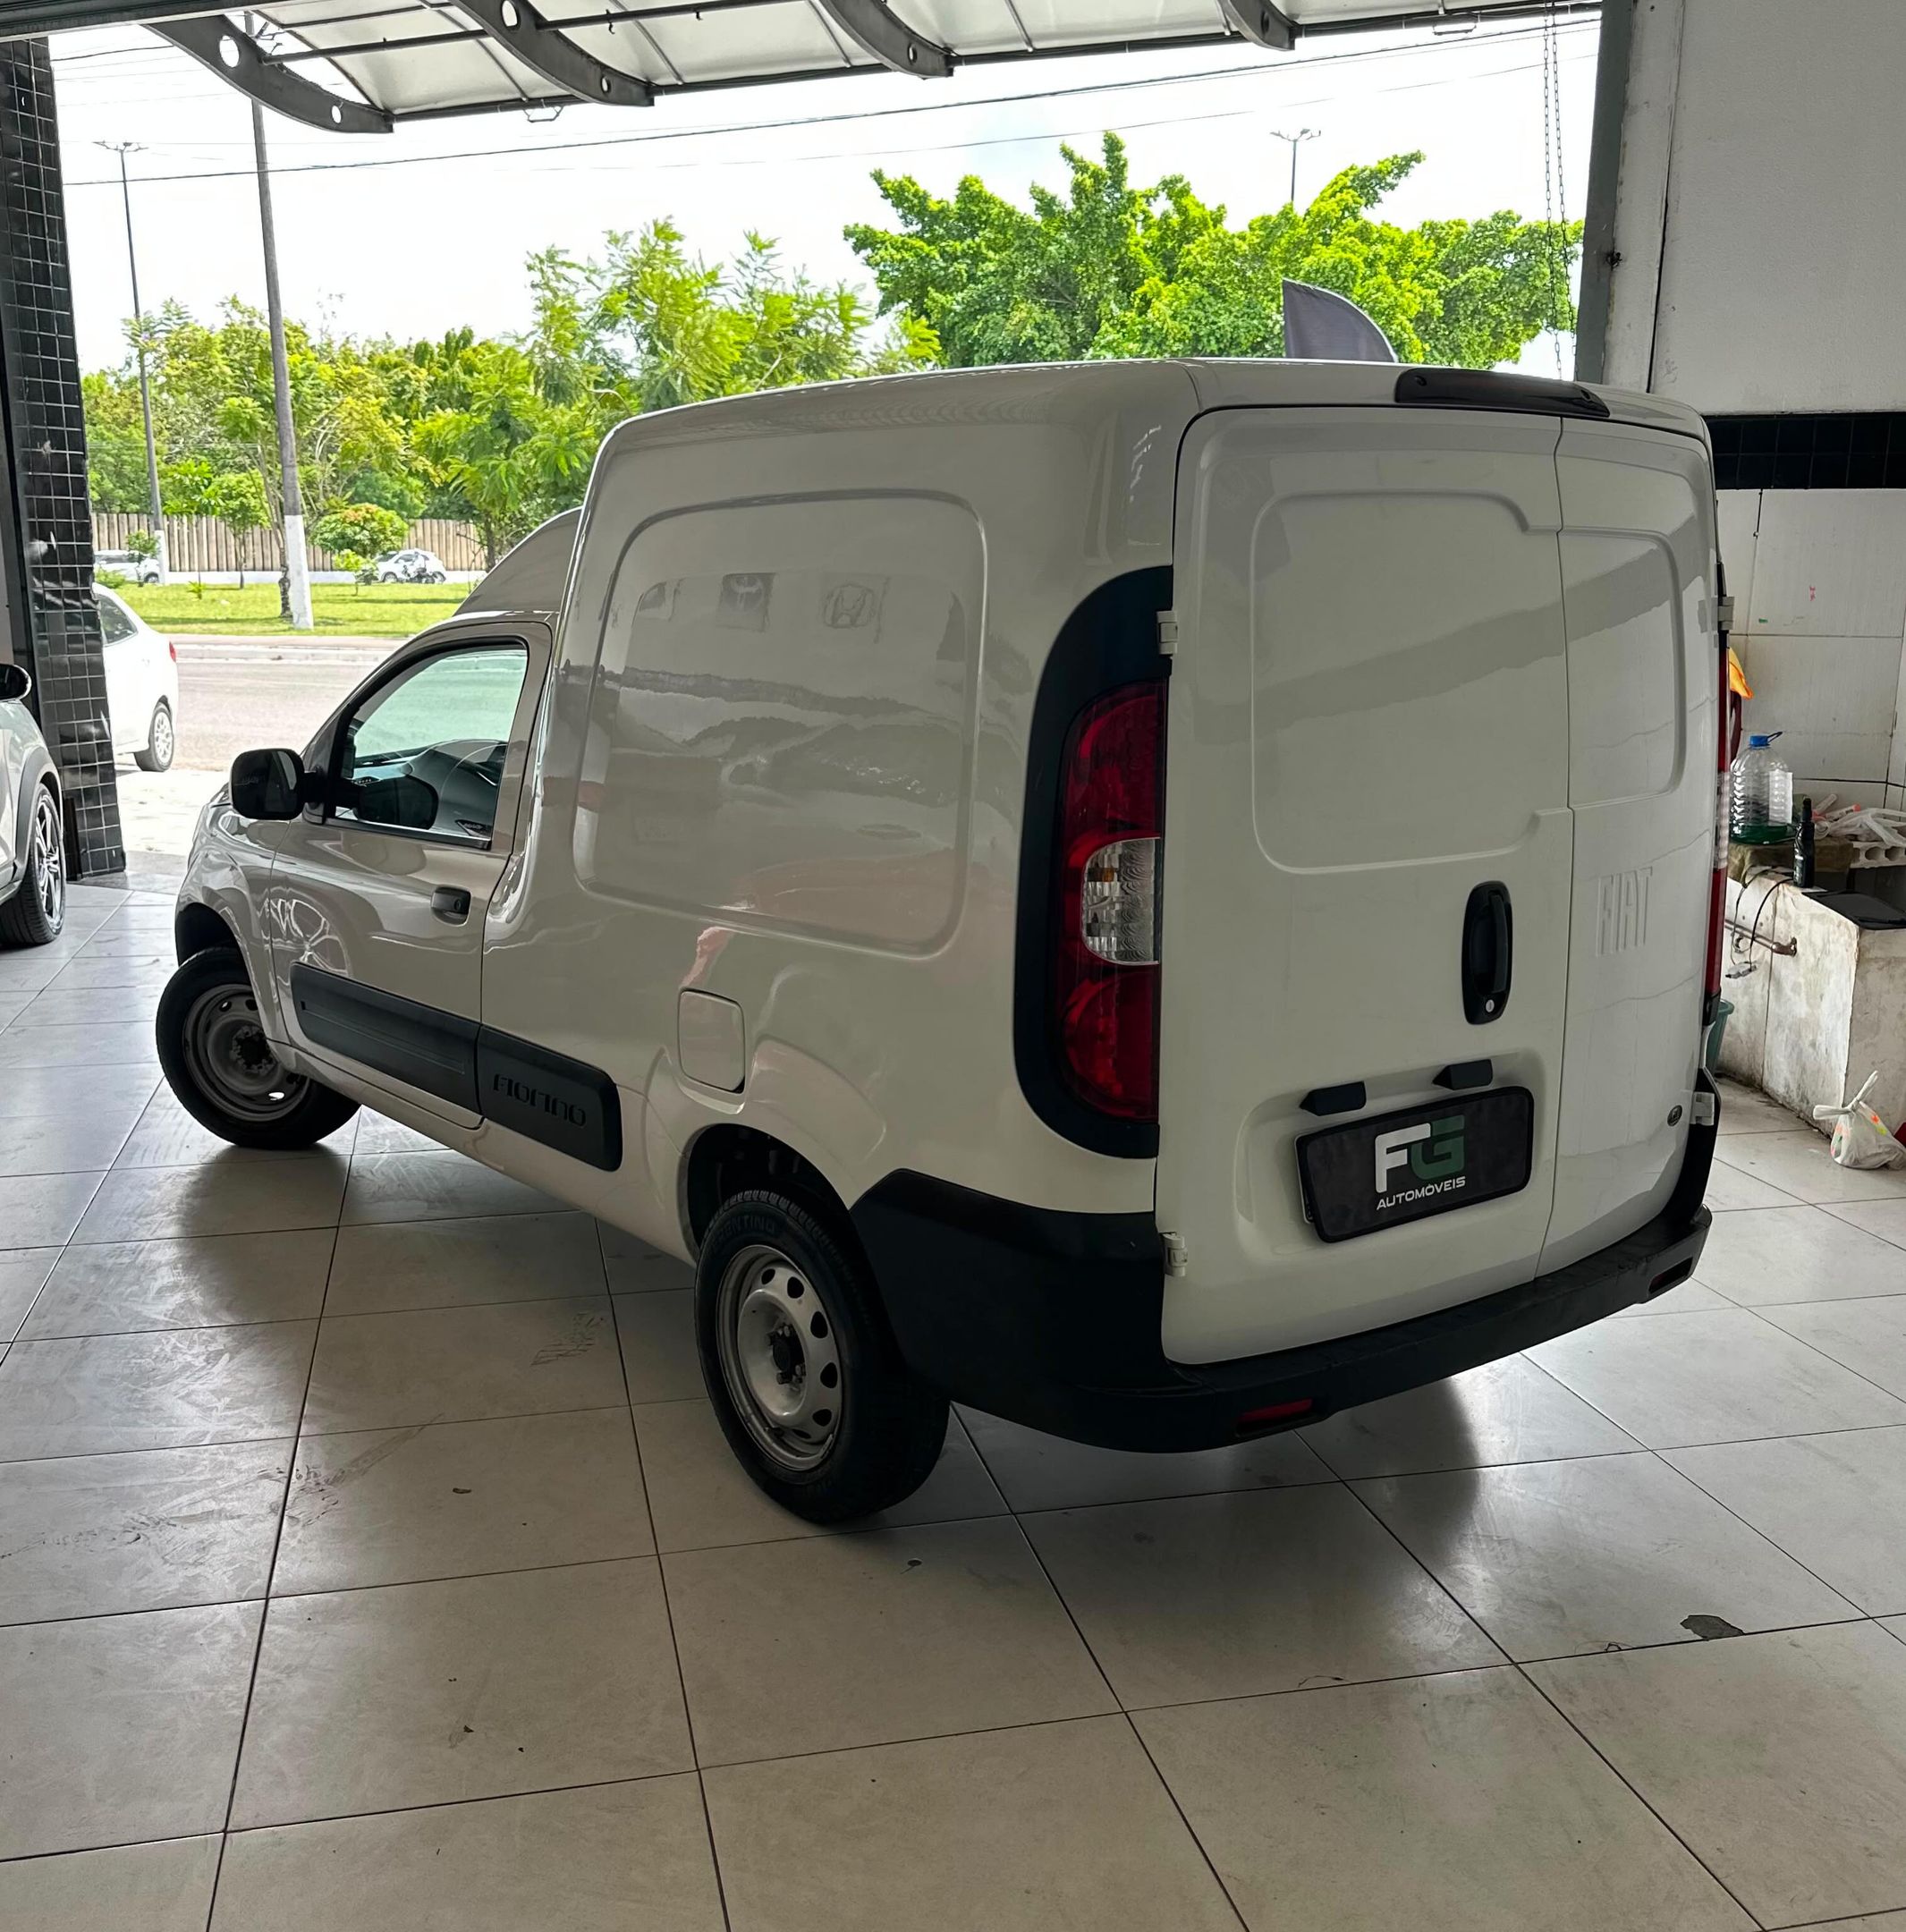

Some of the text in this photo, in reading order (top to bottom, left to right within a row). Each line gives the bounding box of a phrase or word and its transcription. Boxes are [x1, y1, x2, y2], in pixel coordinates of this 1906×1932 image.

[1595, 865, 1653, 957] FIAT
[493, 1073, 587, 1127] FIORINO
[1375, 1114, 1465, 1193] FG
[1376, 1175, 1466, 1210] AUTOMÓVEIS
